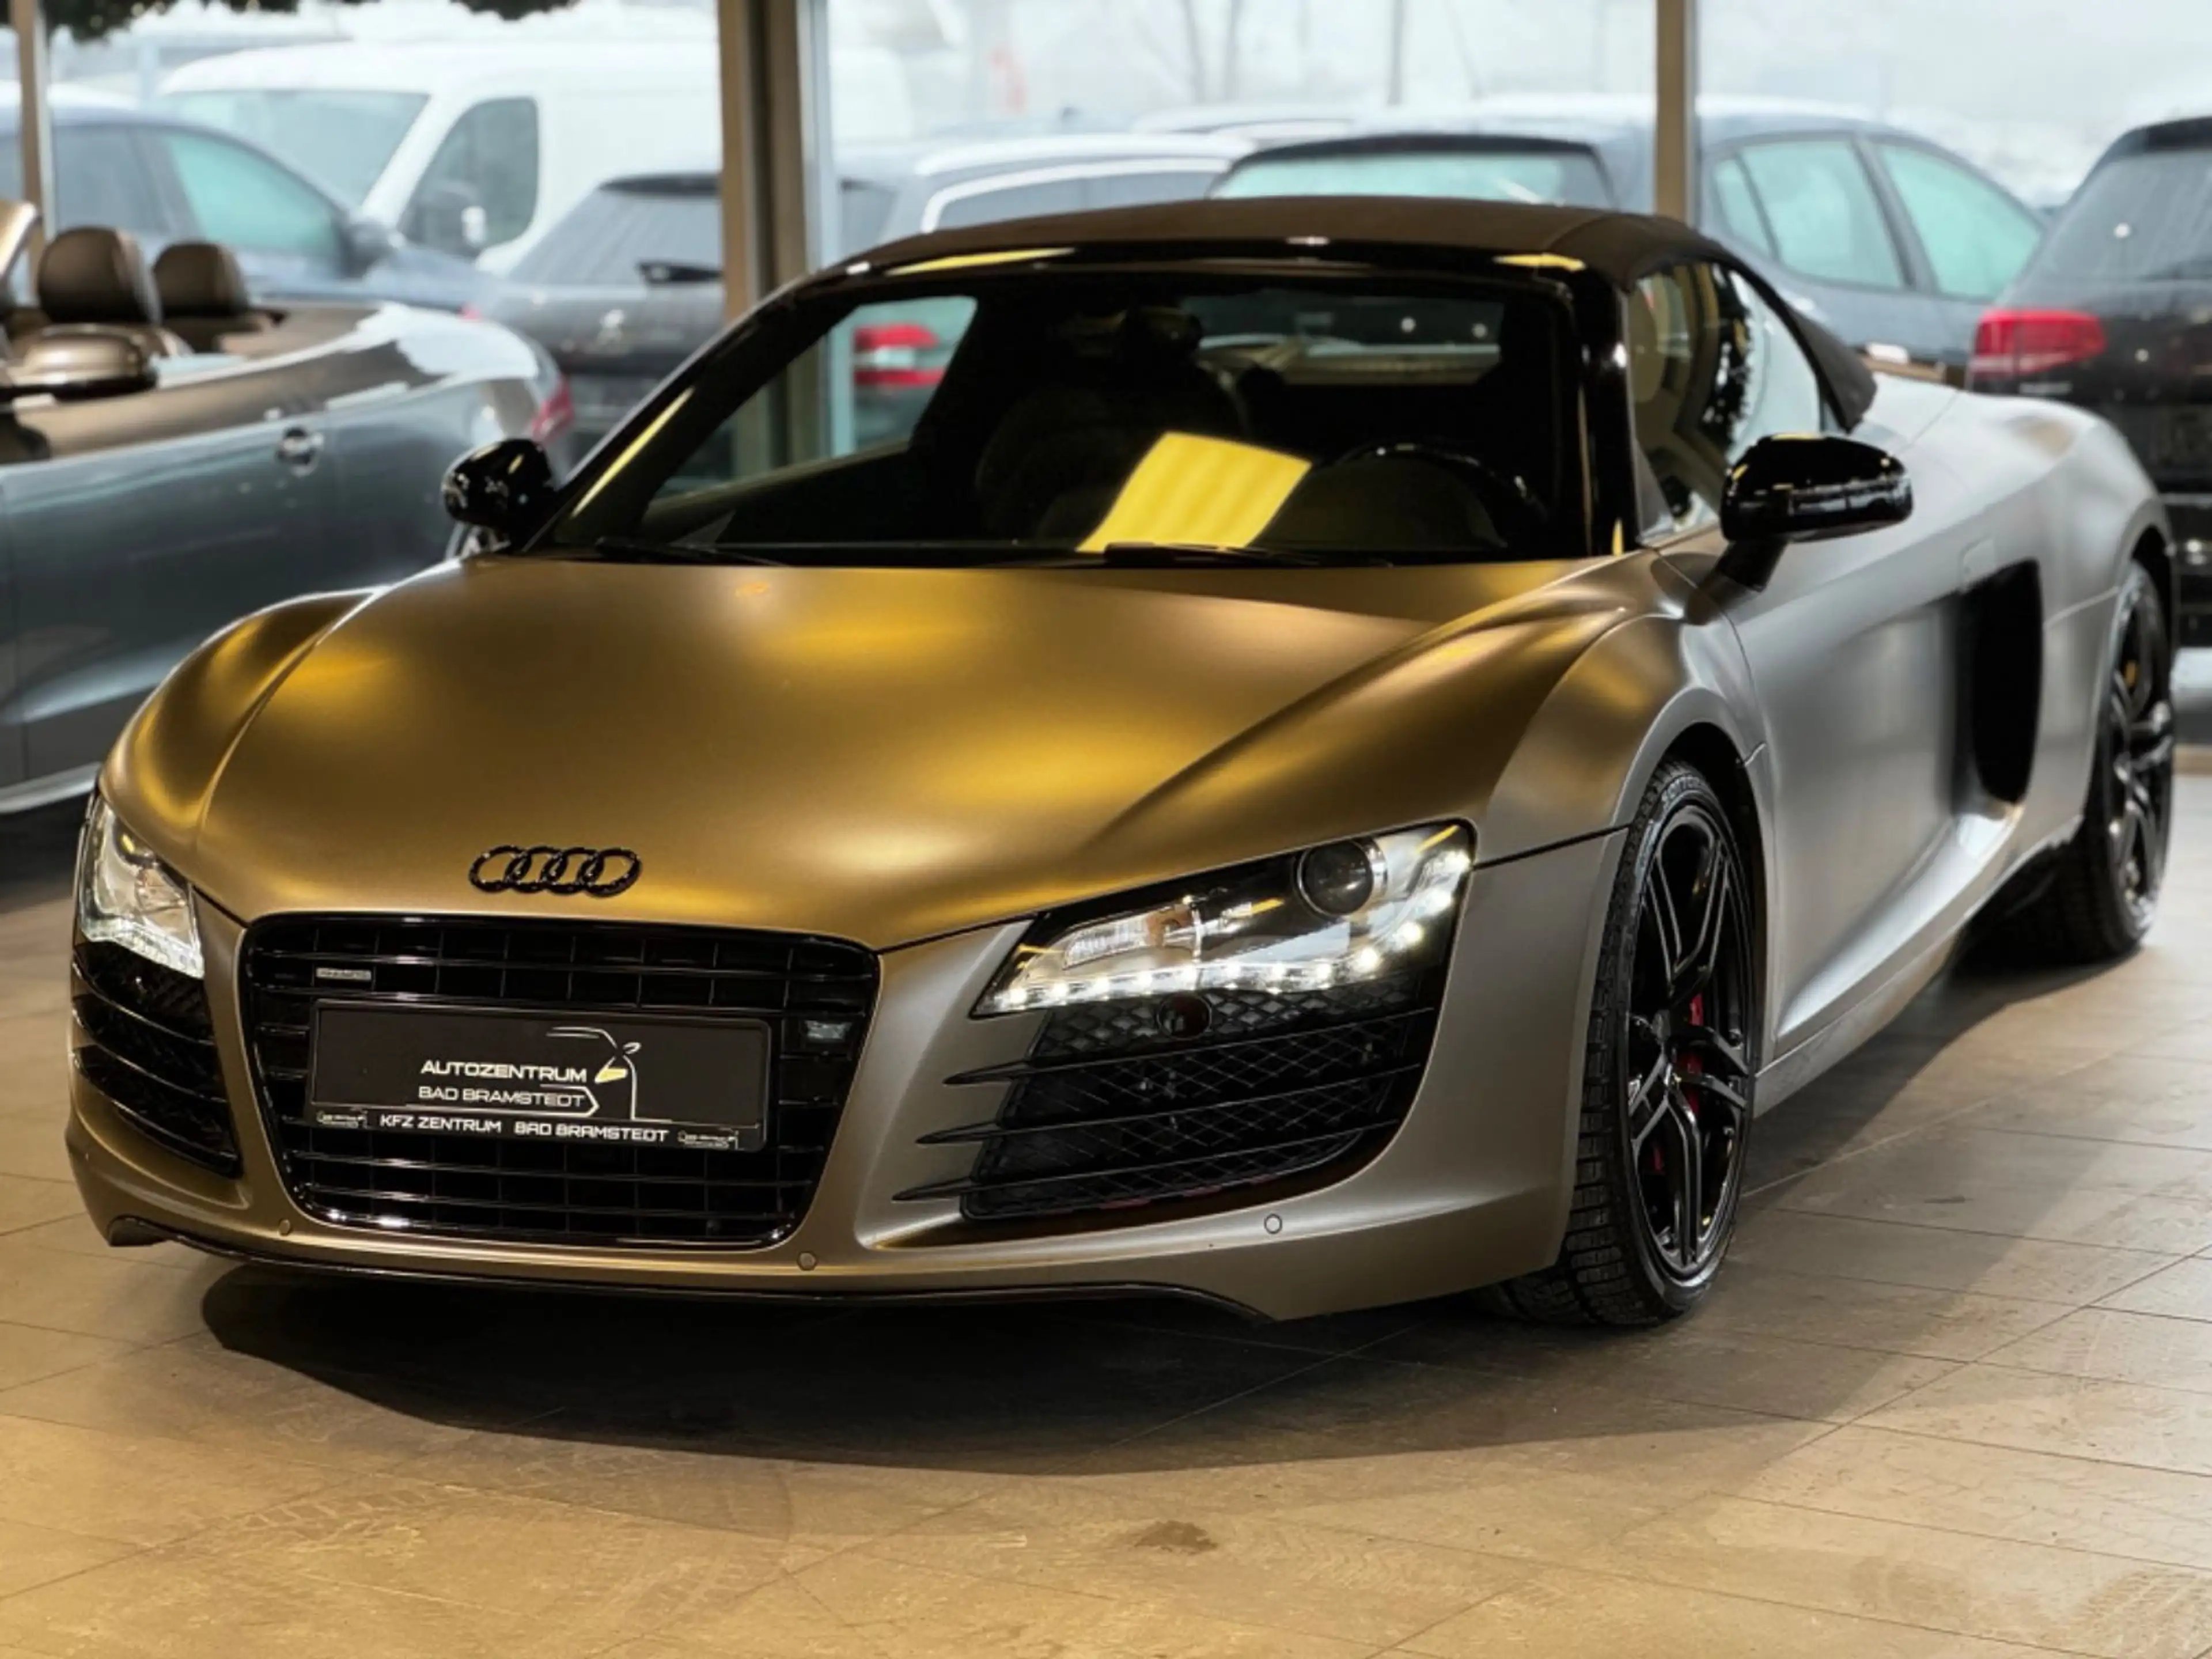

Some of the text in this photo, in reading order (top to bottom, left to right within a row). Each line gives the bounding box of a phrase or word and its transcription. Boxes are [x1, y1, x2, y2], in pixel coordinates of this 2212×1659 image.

[421, 1059, 587, 1083] AUTOZENTRUM
[418, 1085, 585, 1107] BAD BRAMSTEDT
[380, 1113, 415, 1128] KFZ
[417, 1116, 502, 1134] ZENTRUM
[514, 1121, 552, 1136] BAD
[555, 1123, 670, 1142] BRAMSTEDT
